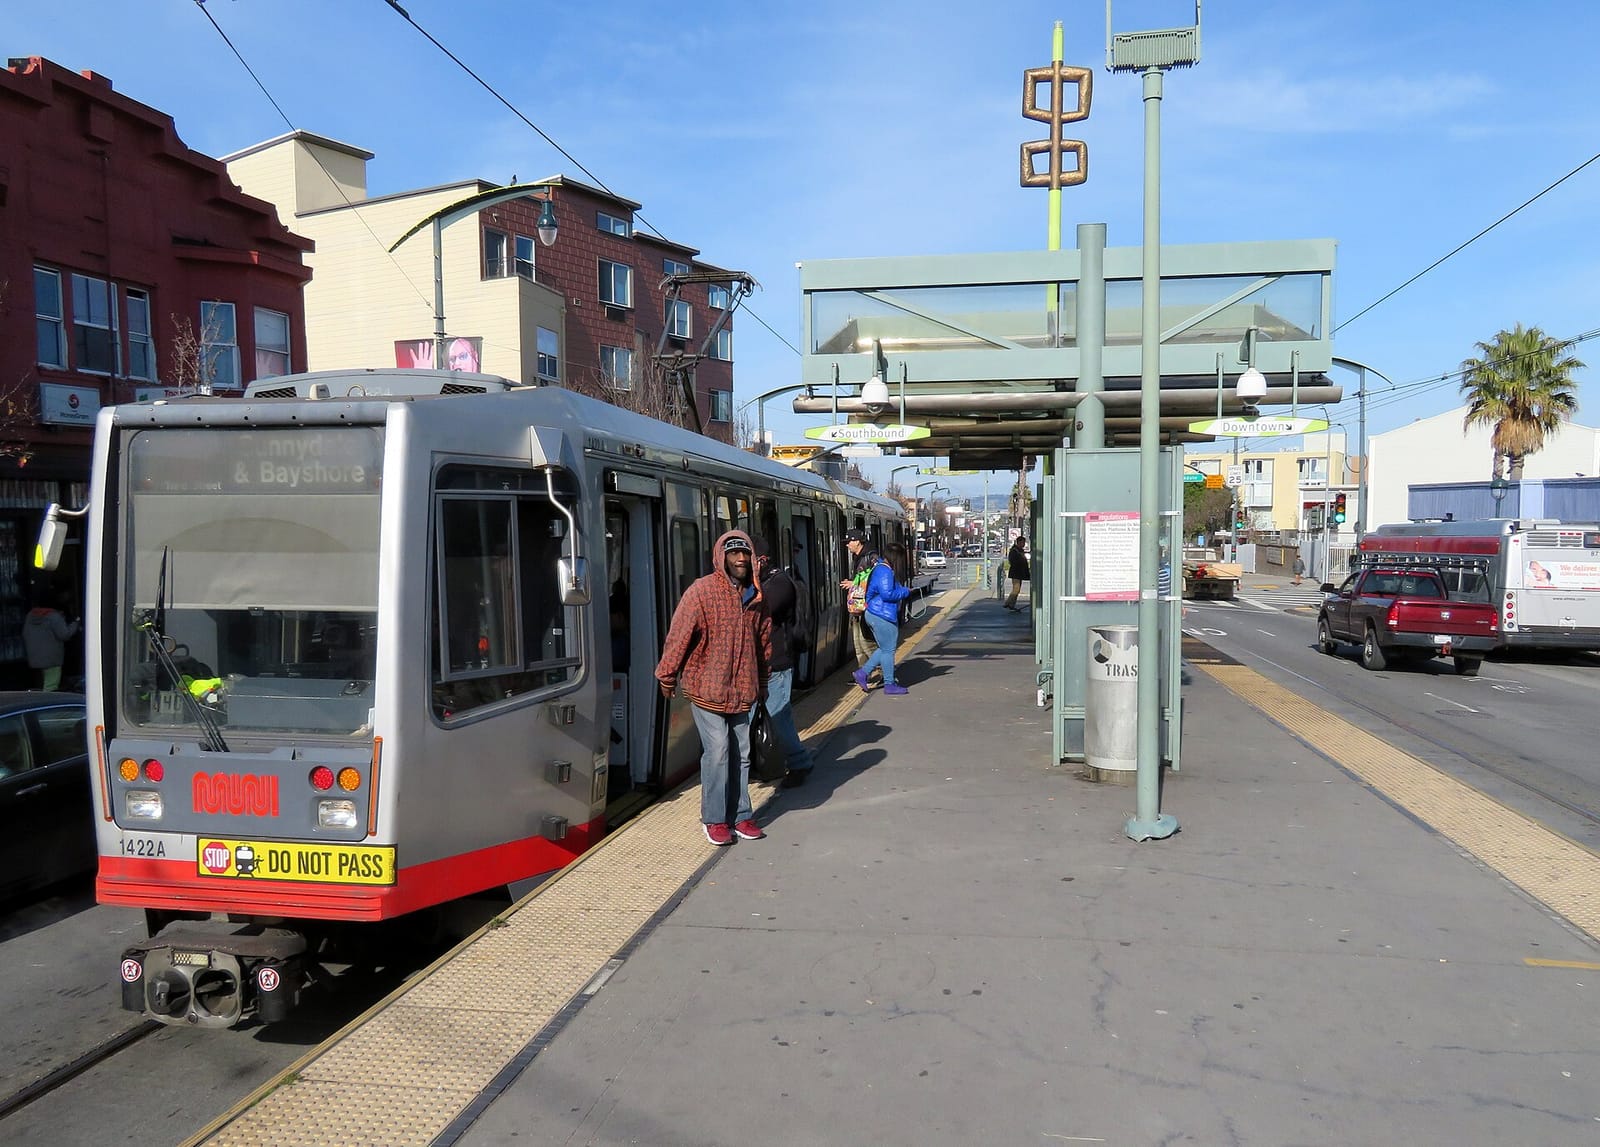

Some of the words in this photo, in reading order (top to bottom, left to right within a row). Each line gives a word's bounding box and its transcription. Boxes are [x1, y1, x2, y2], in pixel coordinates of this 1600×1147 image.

[838, 428, 904, 439] Southbound
[1222, 422, 1285, 433] Downtown
[235, 461, 249, 484] &
[260, 460, 365, 488] Bayshore
[1228, 475, 1242, 485] 25
[1105, 663, 1138, 677] TRAS
[119, 838, 166, 857] 1422A
[205, 847, 229, 869] STOP
[269, 848, 291, 874] DO
[298, 850, 332, 876] NOT
[338, 853, 383, 878] PASS
